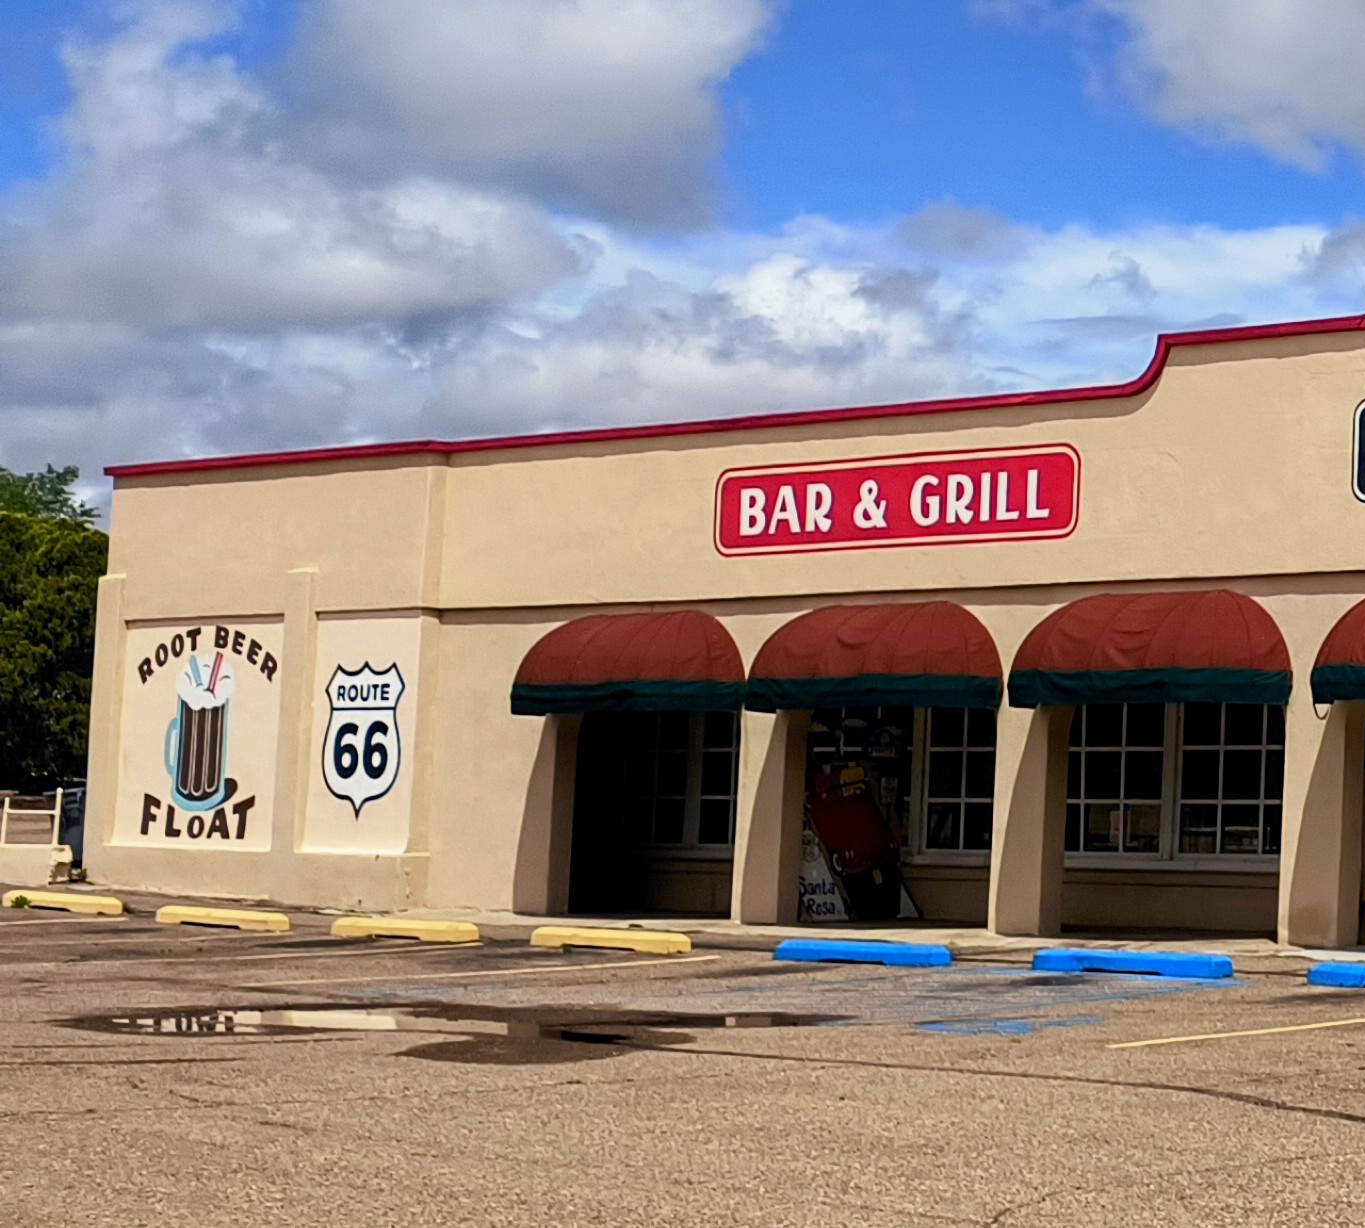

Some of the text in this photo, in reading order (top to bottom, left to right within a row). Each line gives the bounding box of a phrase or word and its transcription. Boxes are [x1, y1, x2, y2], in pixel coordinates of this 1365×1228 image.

[739, 469, 1050, 537] BAR & GRILL
[137, 625, 278, 684] ROOT BEER
[336, 683, 391, 702] ROUTE
[333, 720, 389, 779] 66
[140, 792, 256, 840] FLOAT
